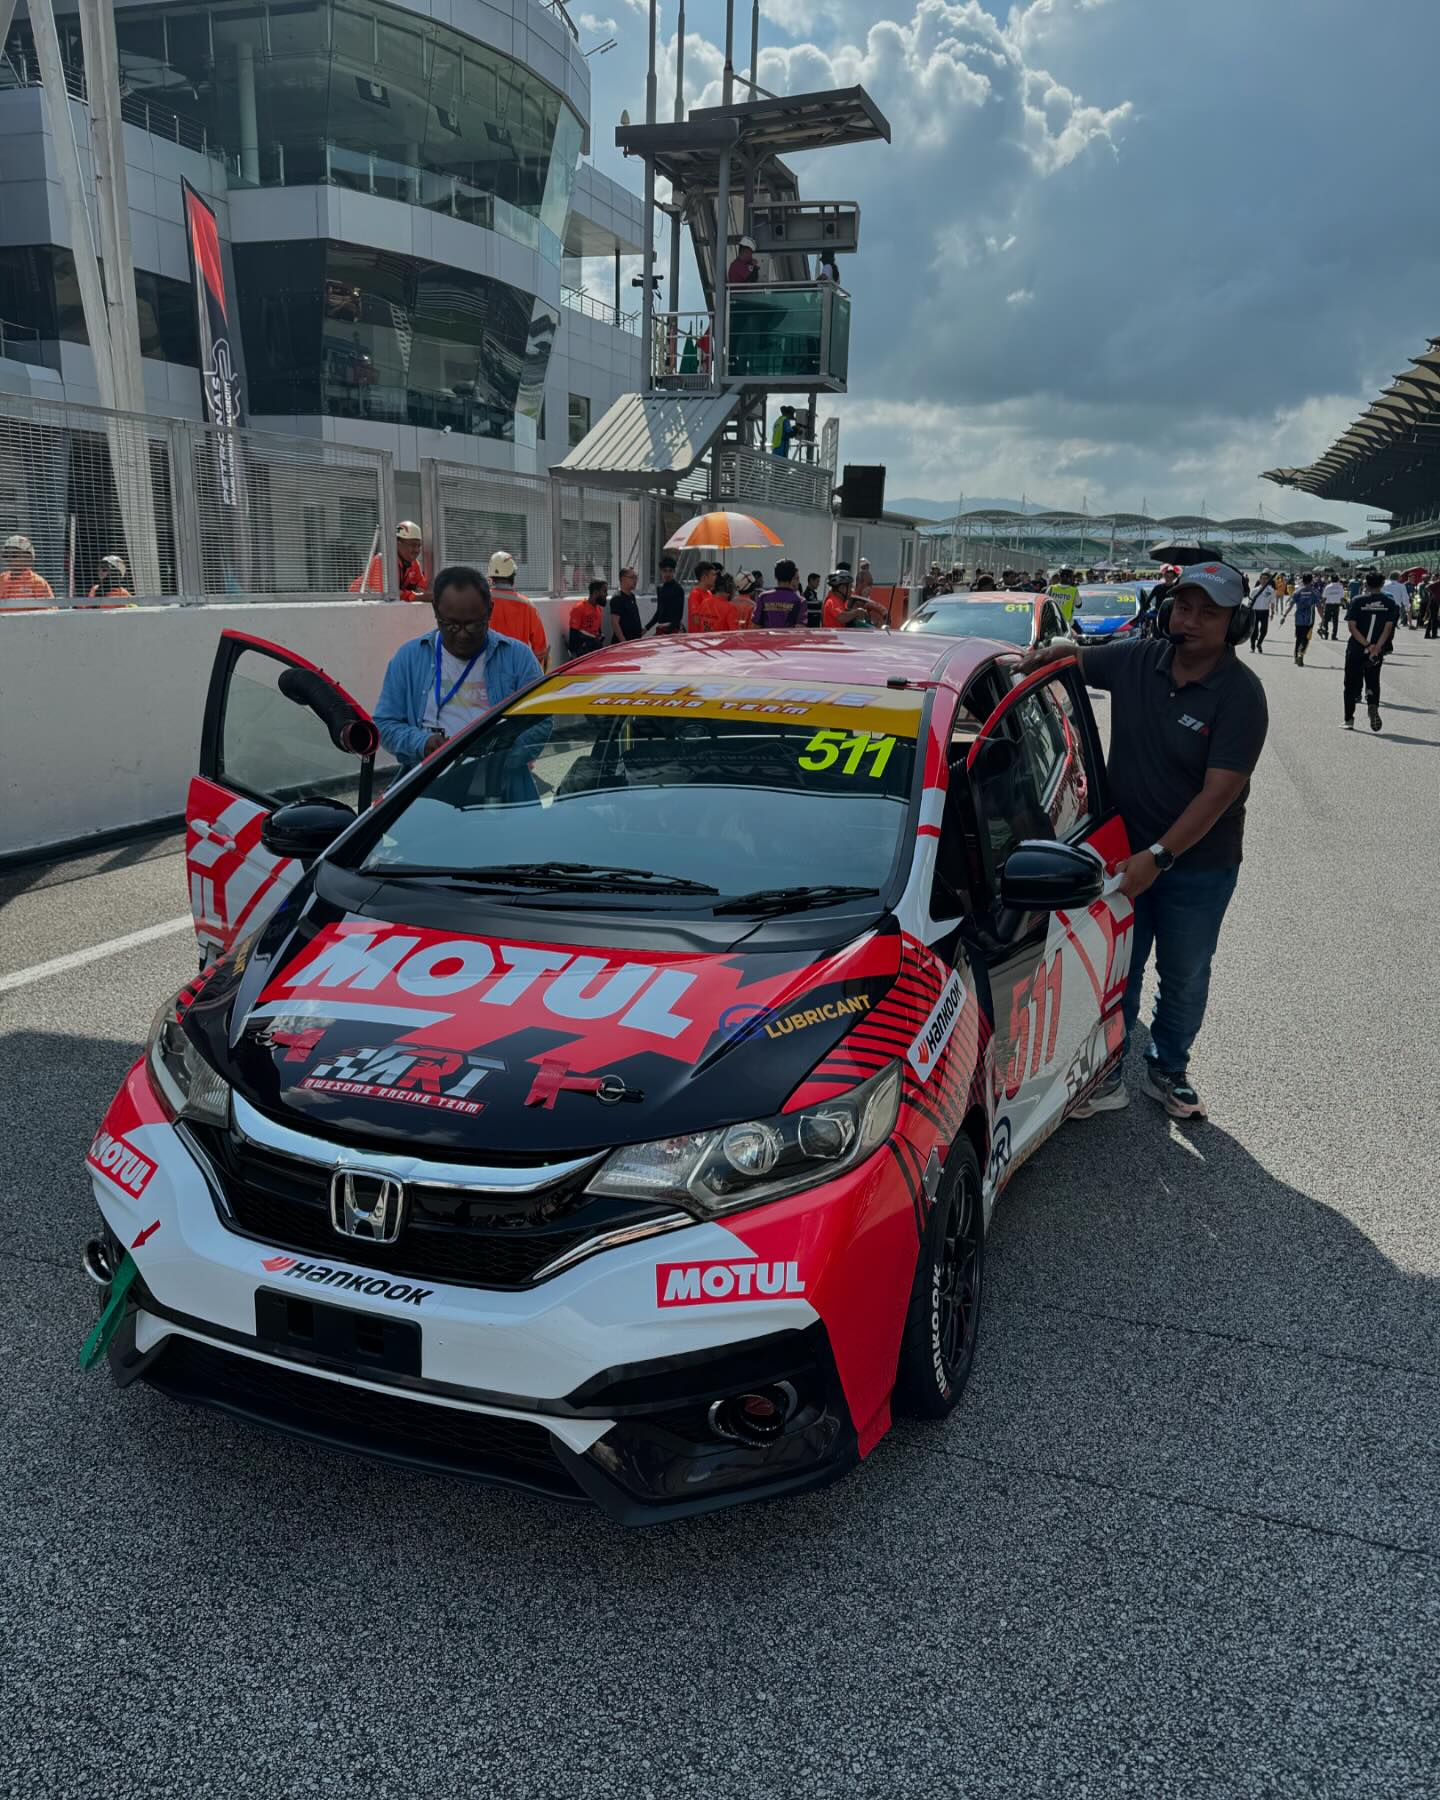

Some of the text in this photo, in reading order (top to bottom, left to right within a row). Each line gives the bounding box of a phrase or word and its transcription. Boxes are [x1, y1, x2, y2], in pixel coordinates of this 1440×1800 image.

[224, 381, 232, 414] CIRCUIT
[1004, 604, 1031, 613] 611
[555, 679, 883, 708] AWESOME
[589, 696, 812, 716] RACING TEAM
[798, 731, 897, 778] 511
[282, 932, 698, 1040] MOTUL
[763, 994, 873, 1040] LUBRICANT
[1006, 948, 1063, 1100] 511
[303, 1077, 481, 1115] AWESOME RACING TEAM
[90, 1131, 152, 1193] MOTUL
[662, 1260, 806, 1302] MOTUL
